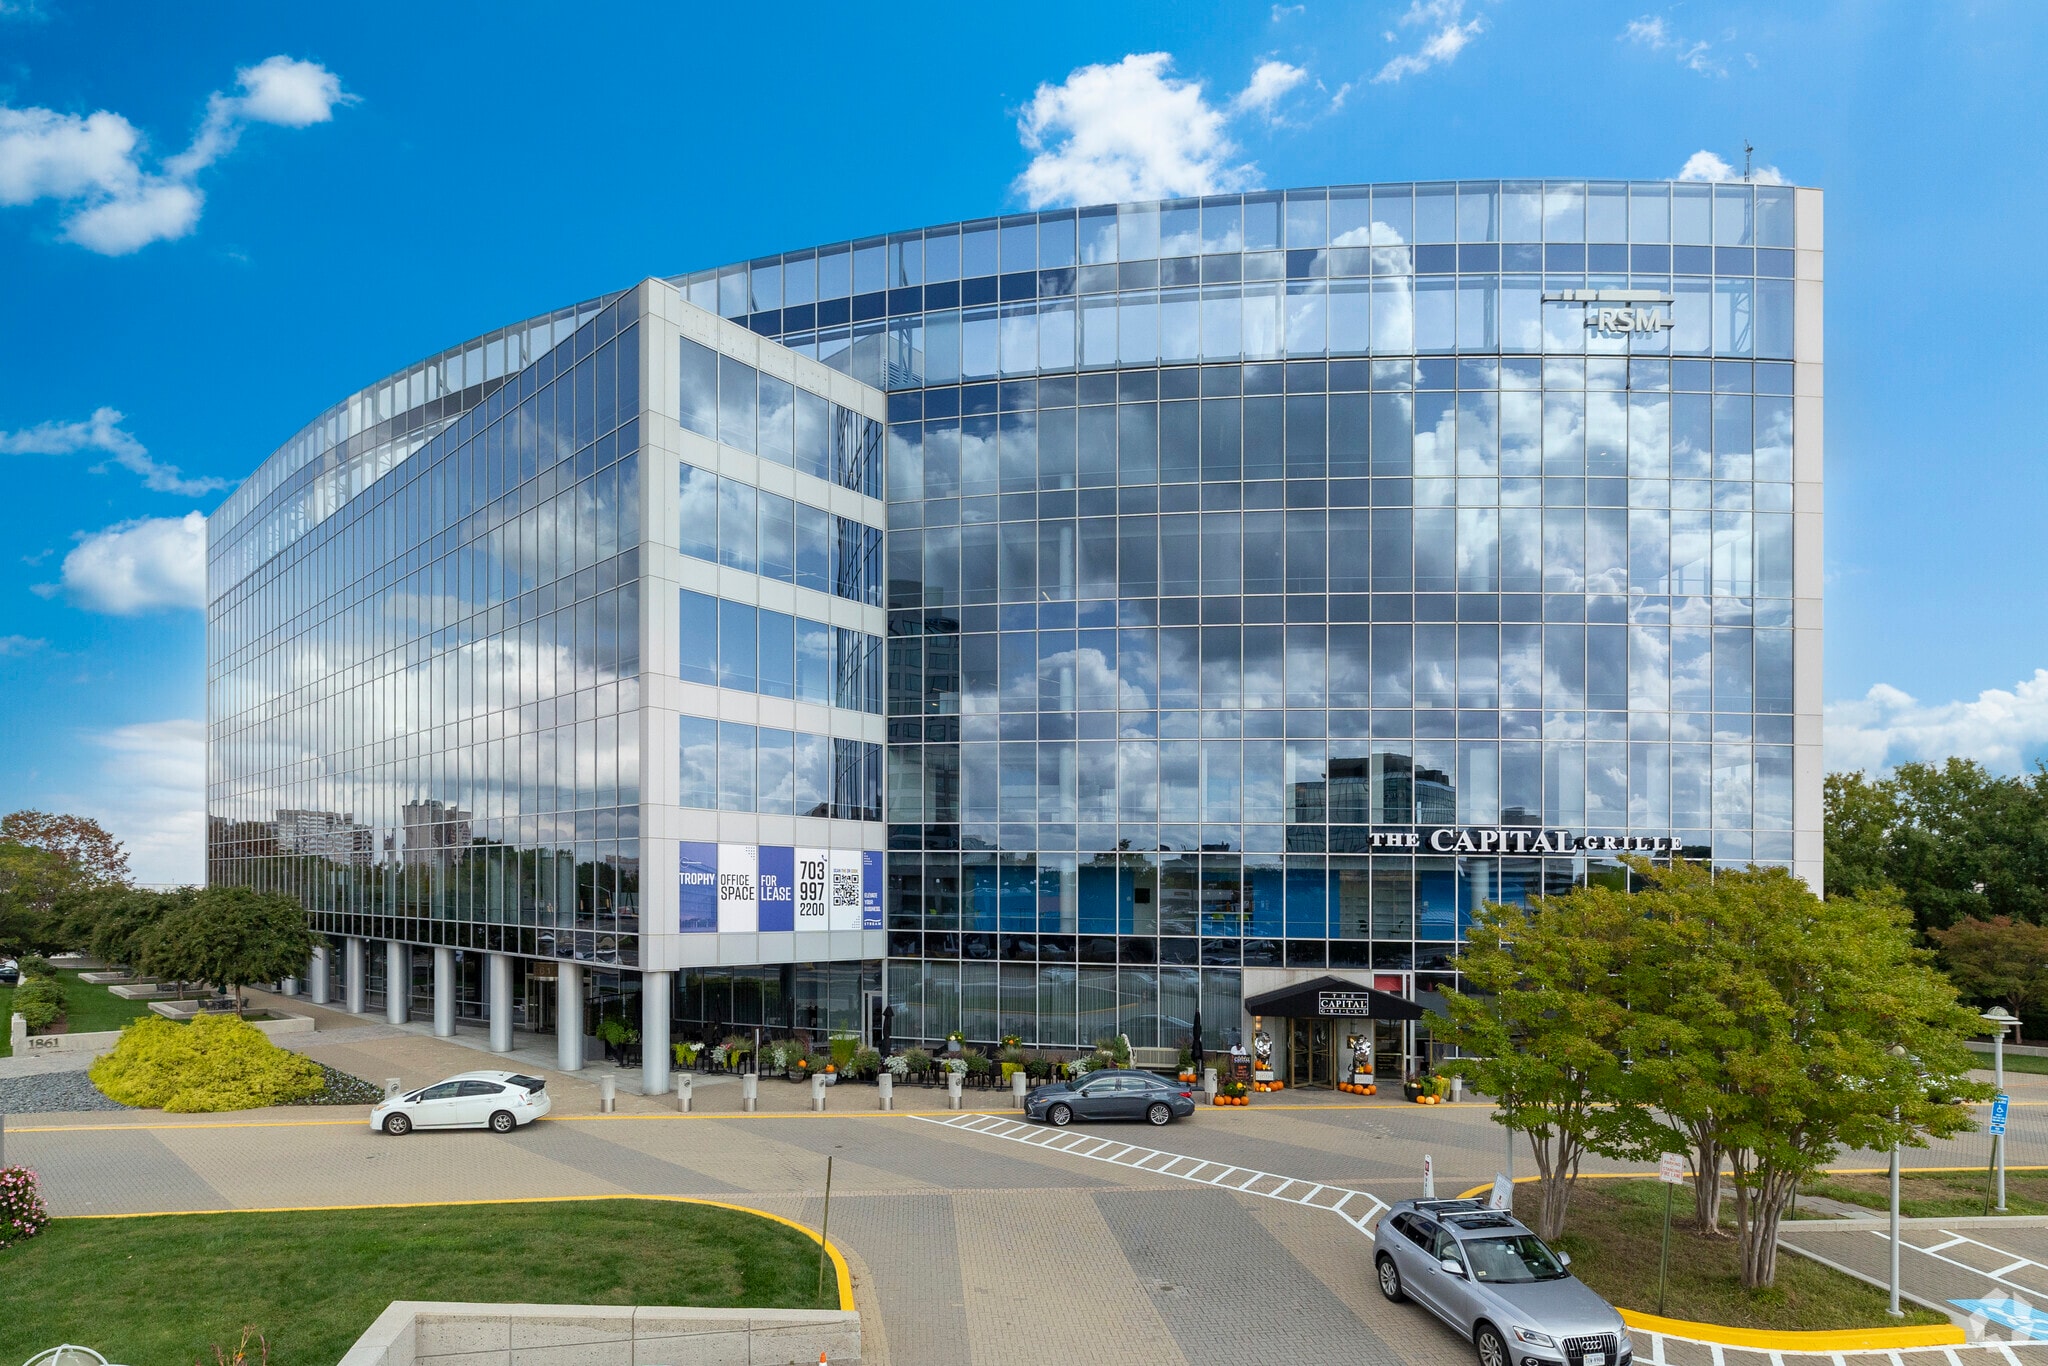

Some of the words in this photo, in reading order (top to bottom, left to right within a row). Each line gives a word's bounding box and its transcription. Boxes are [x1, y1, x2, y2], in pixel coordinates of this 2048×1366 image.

[1598, 307, 1661, 332] RSM
[1370, 832, 1420, 847] THE
[1430, 828, 1577, 853] CAPITAL
[800, 861, 825, 880] 703
[680, 872, 715, 885] TROPHY
[720, 873, 750, 886] OFFICE
[761, 874, 777, 887] FOR
[720, 886, 755, 901] SPACE
[761, 886, 792, 901] LEASE
[800, 882, 825, 901] 997
[800, 902, 825, 916] 2200
[1320, 999, 1367, 1008] CAPITAL
[28, 1037, 60, 1050] 1861
